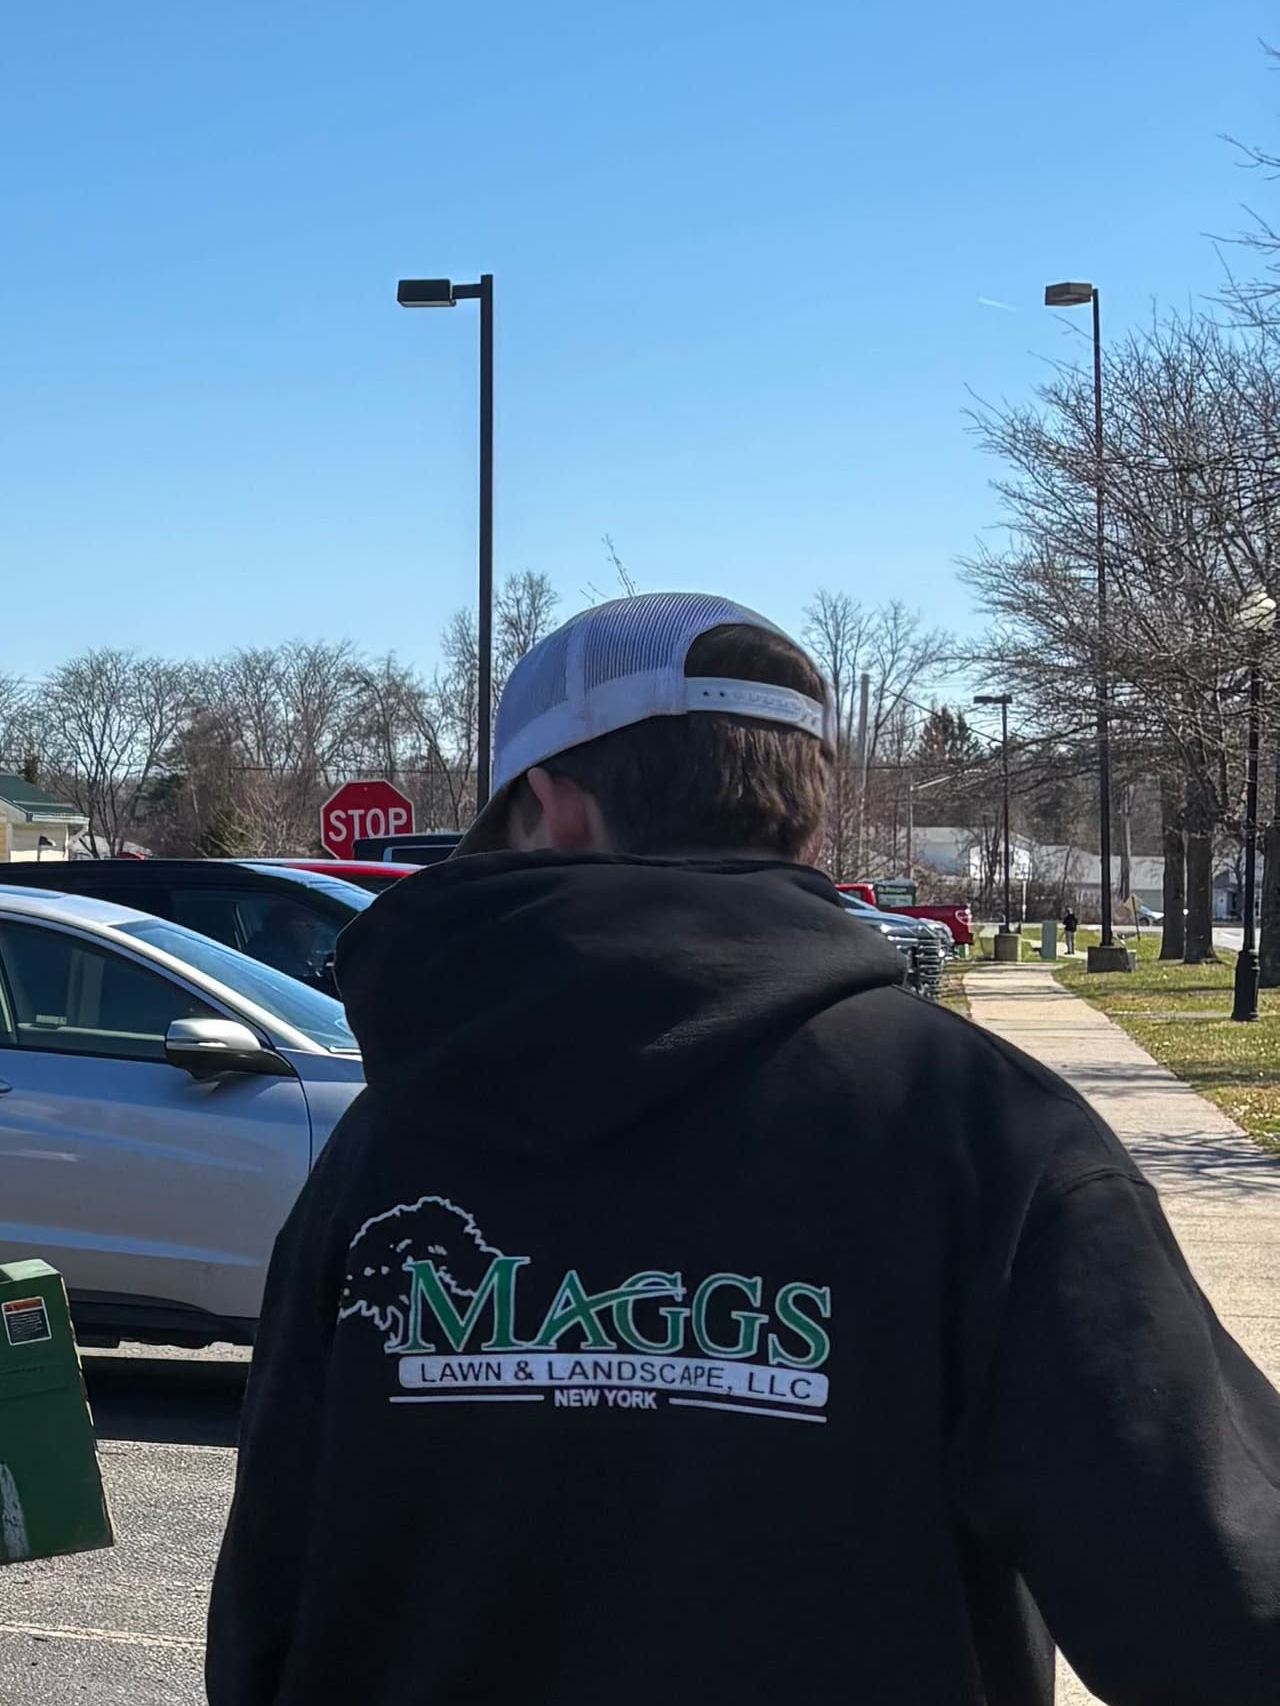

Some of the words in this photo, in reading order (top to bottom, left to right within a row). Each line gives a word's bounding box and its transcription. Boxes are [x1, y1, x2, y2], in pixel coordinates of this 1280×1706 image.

[328, 807, 408, 842] STOP
[390, 1255, 832, 1370] MAGGS
[420, 1359, 503, 1384] LAWN
[513, 1359, 535, 1381] &
[547, 1358, 734, 1395] LANDSCAPE,
[747, 1371, 813, 1401] LLC
[554, 1389, 601, 1409] NEW
[602, 1389, 658, 1411] YORK
